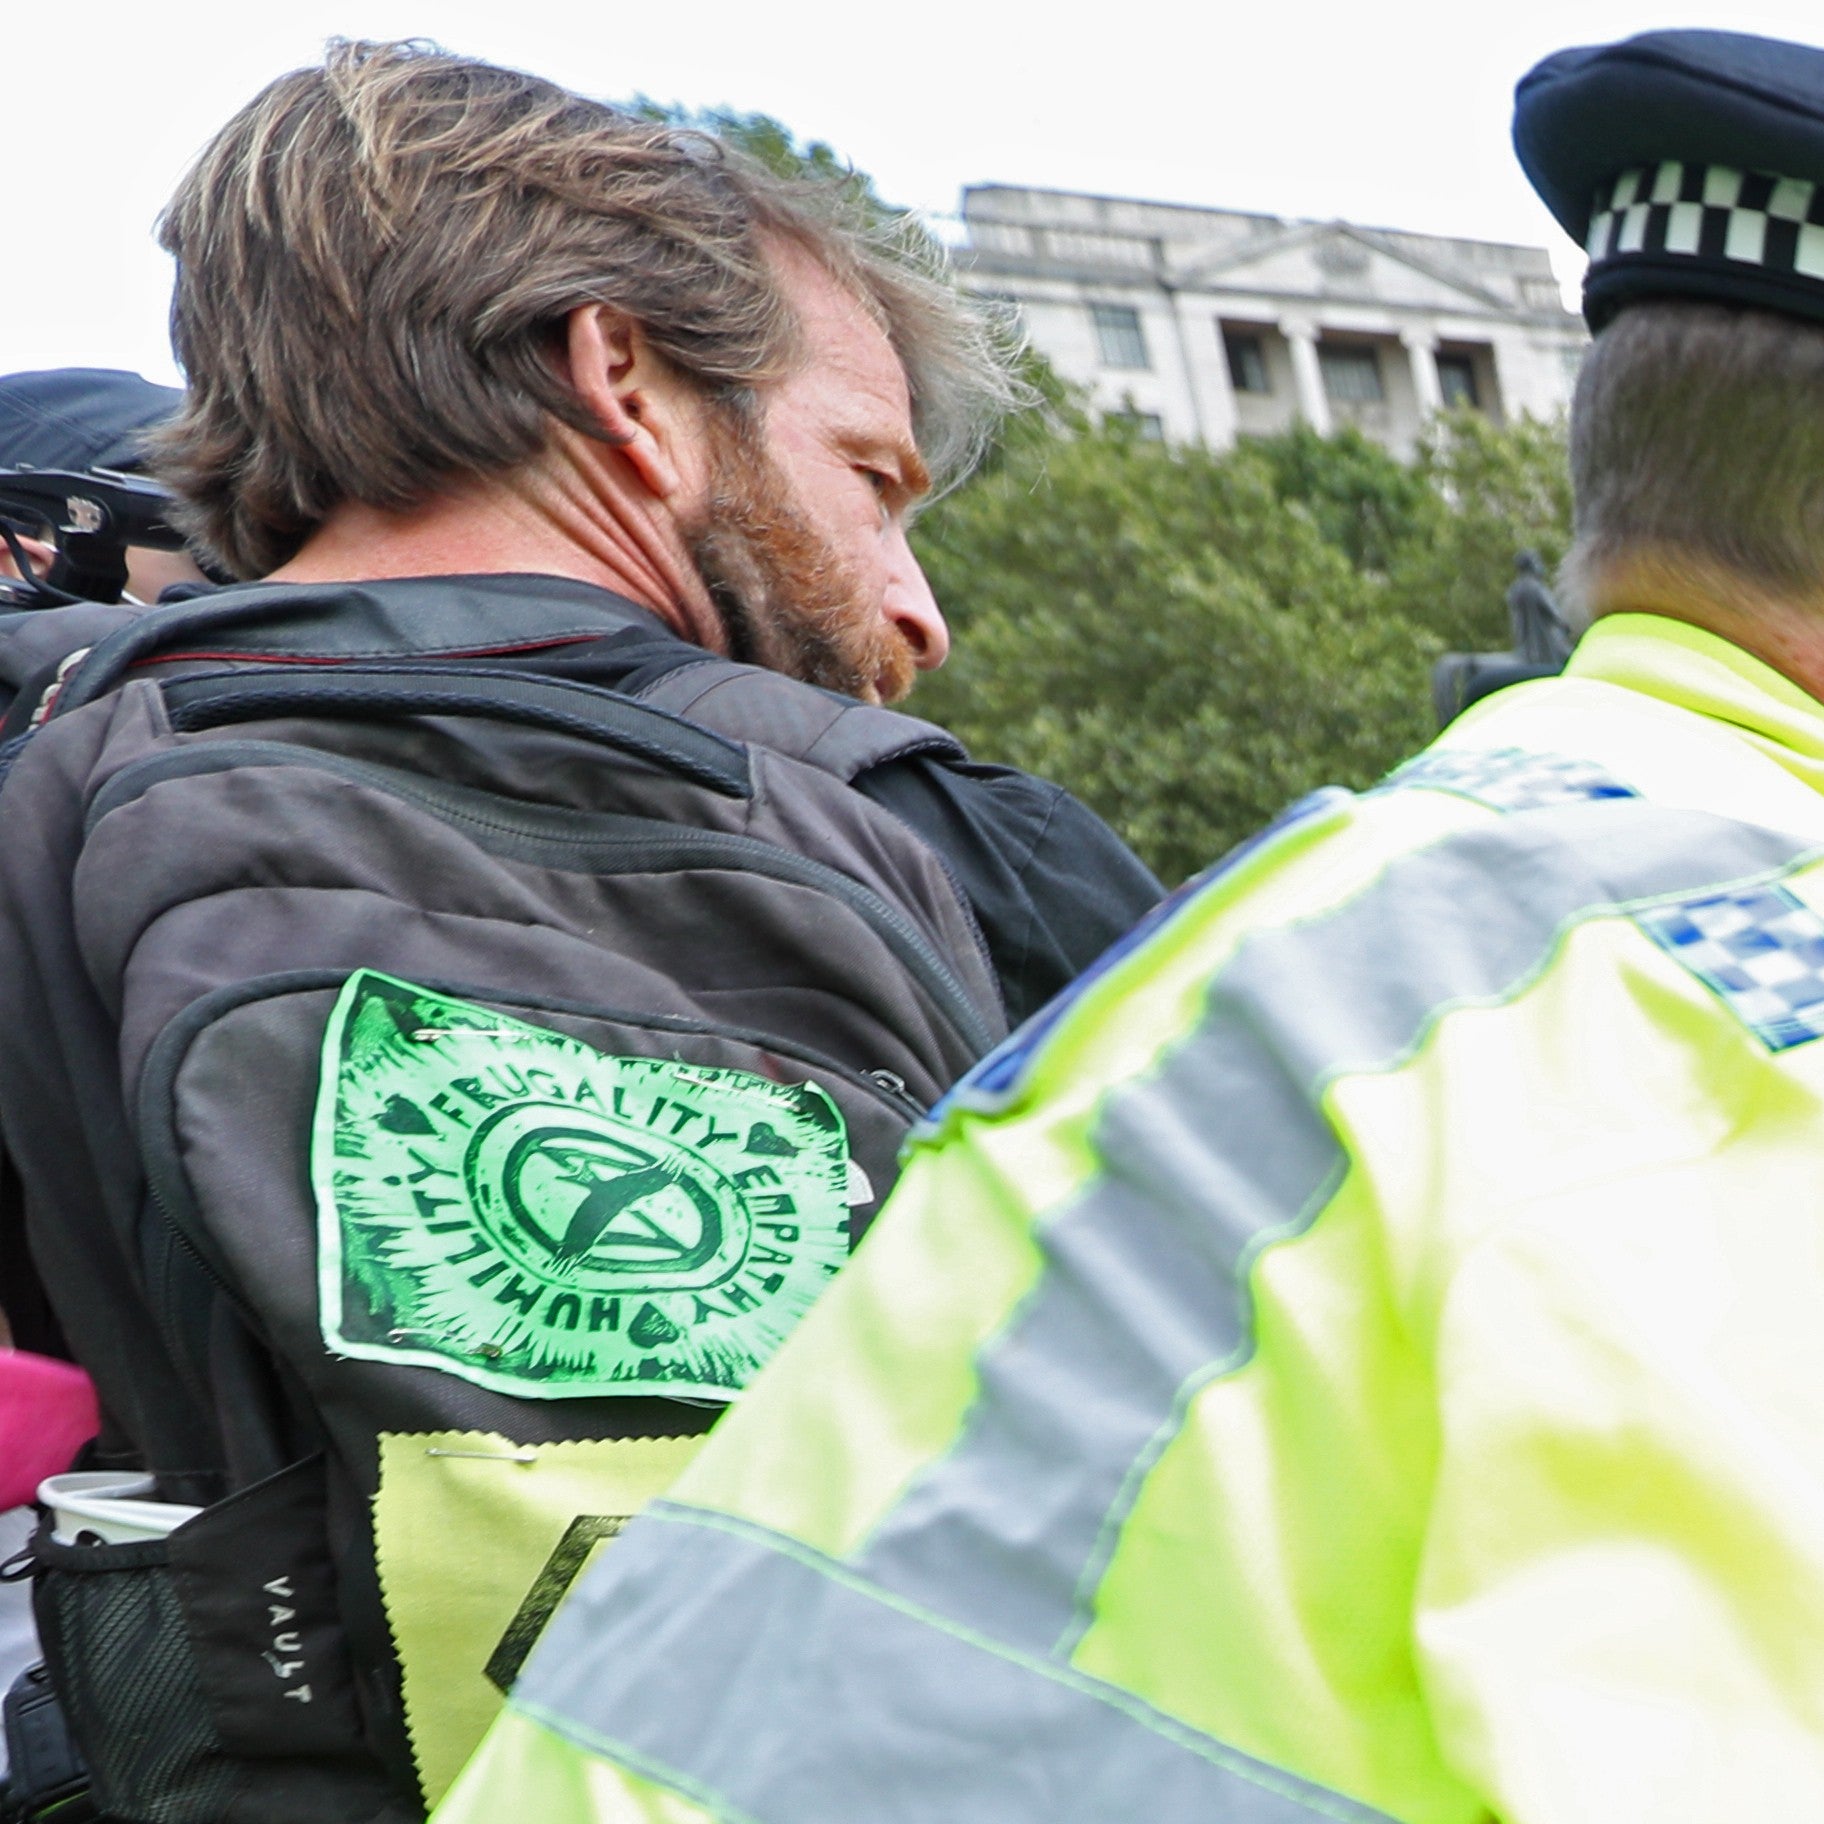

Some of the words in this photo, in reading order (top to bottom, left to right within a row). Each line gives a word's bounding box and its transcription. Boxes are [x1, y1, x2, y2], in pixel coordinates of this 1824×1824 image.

[433, 1061, 738, 1150] FRUGALITY
[408, 1147, 620, 1332] HUMILITY
[690, 1163, 803, 1328] EMPATHY
[261, 1576, 312, 1703] VAULT
